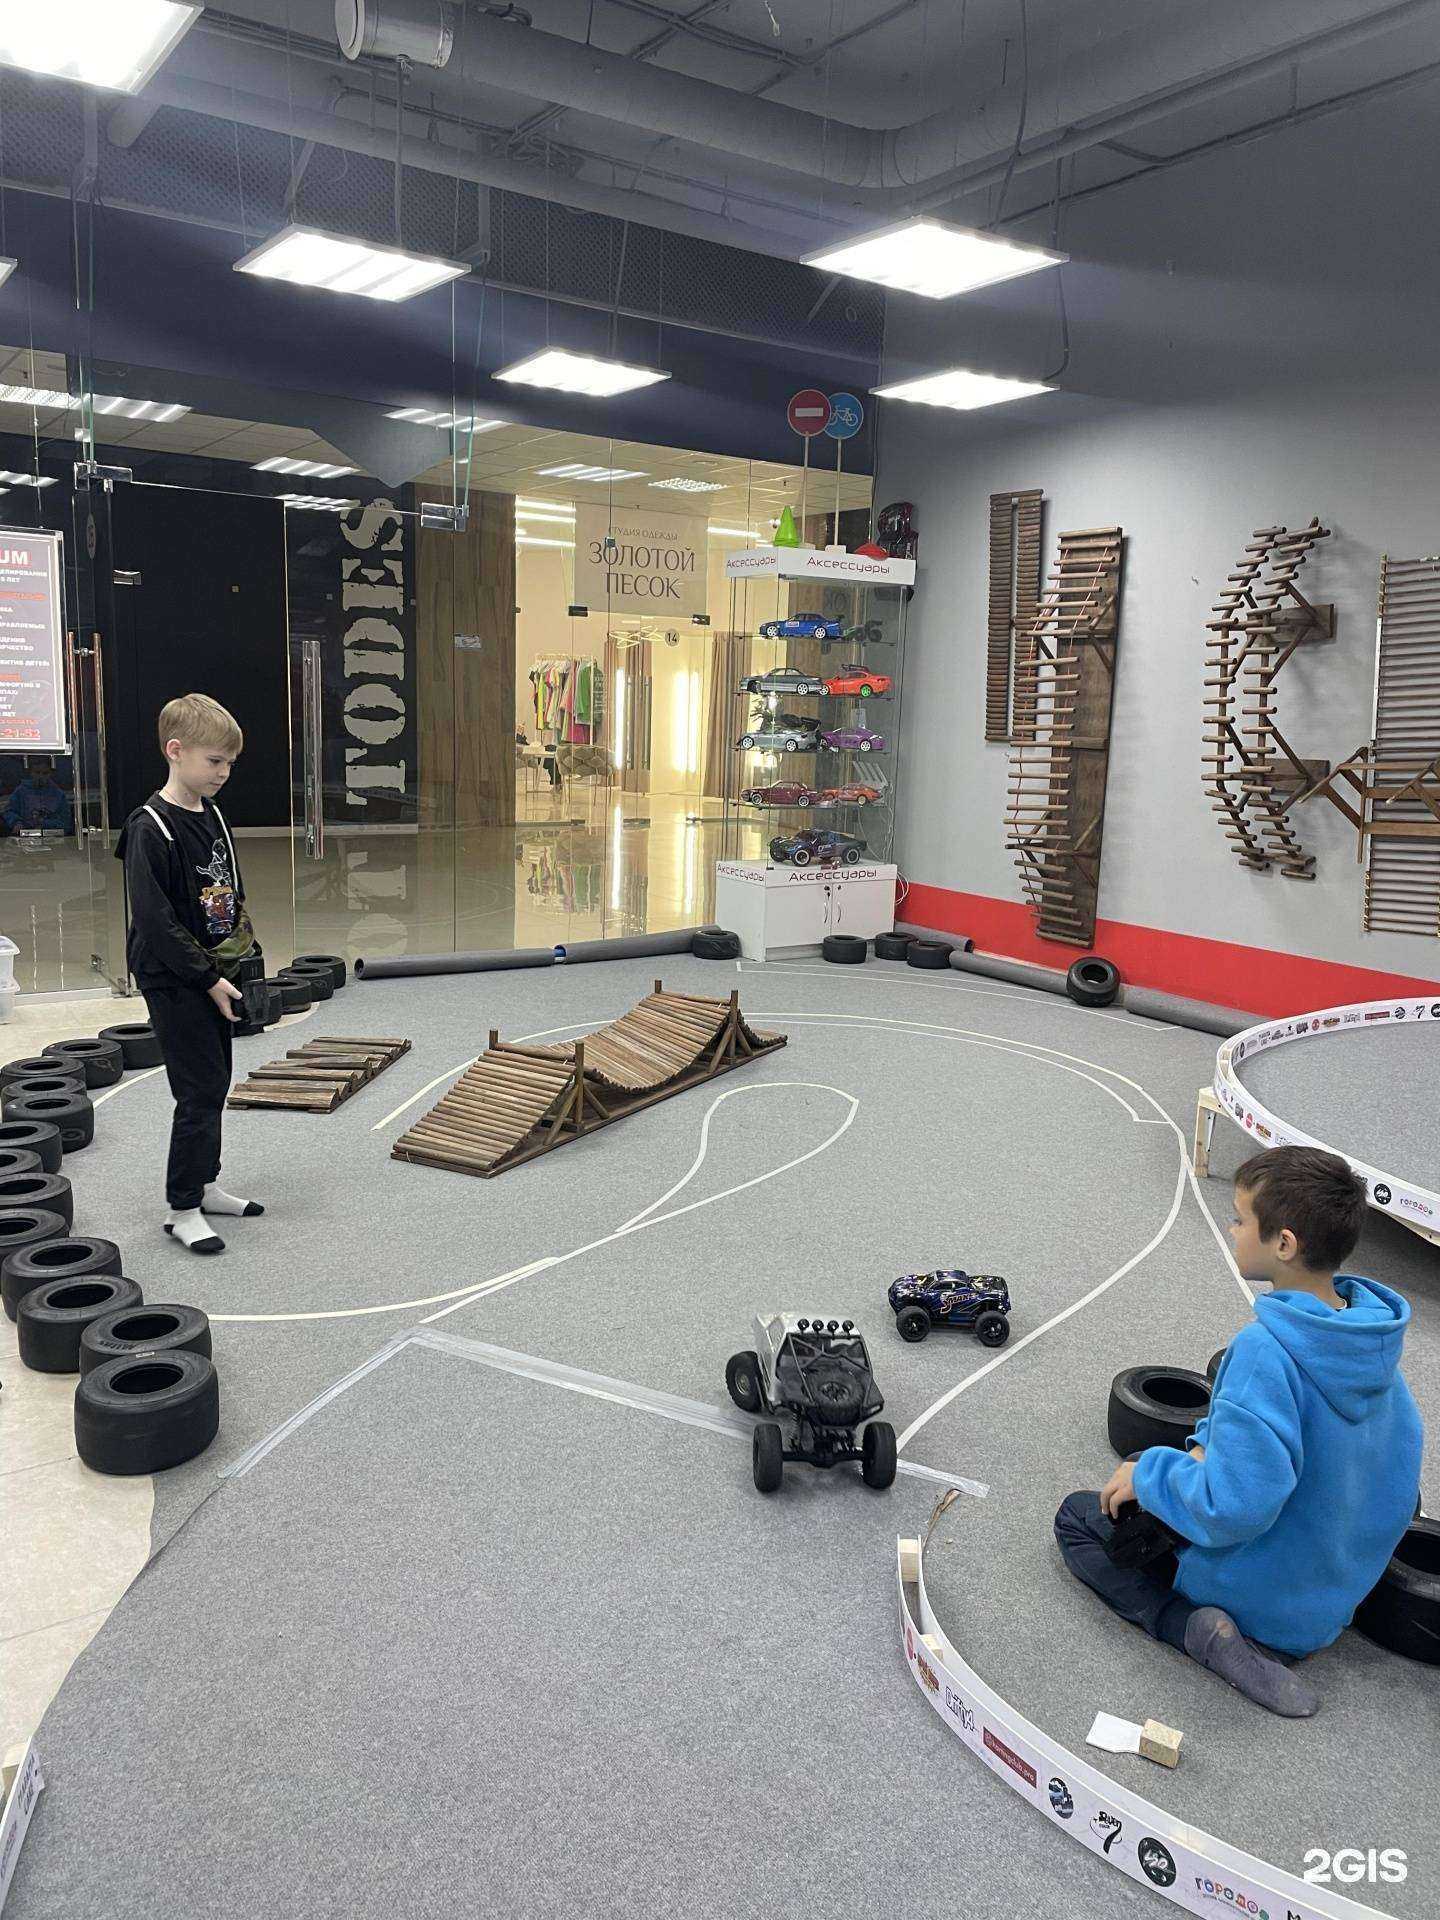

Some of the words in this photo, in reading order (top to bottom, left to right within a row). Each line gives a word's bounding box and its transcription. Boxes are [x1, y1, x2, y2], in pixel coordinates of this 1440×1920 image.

[608, 526, 640, 537] ТУДИЯ
[588, 539, 696, 573] ЗОЛОТОЙ
[604, 571, 681, 600] ПЕСОК
[667, 633, 678, 643] 14
[339, 497, 406, 806] TODES
[788, 869, 877, 882] Аксессуары
